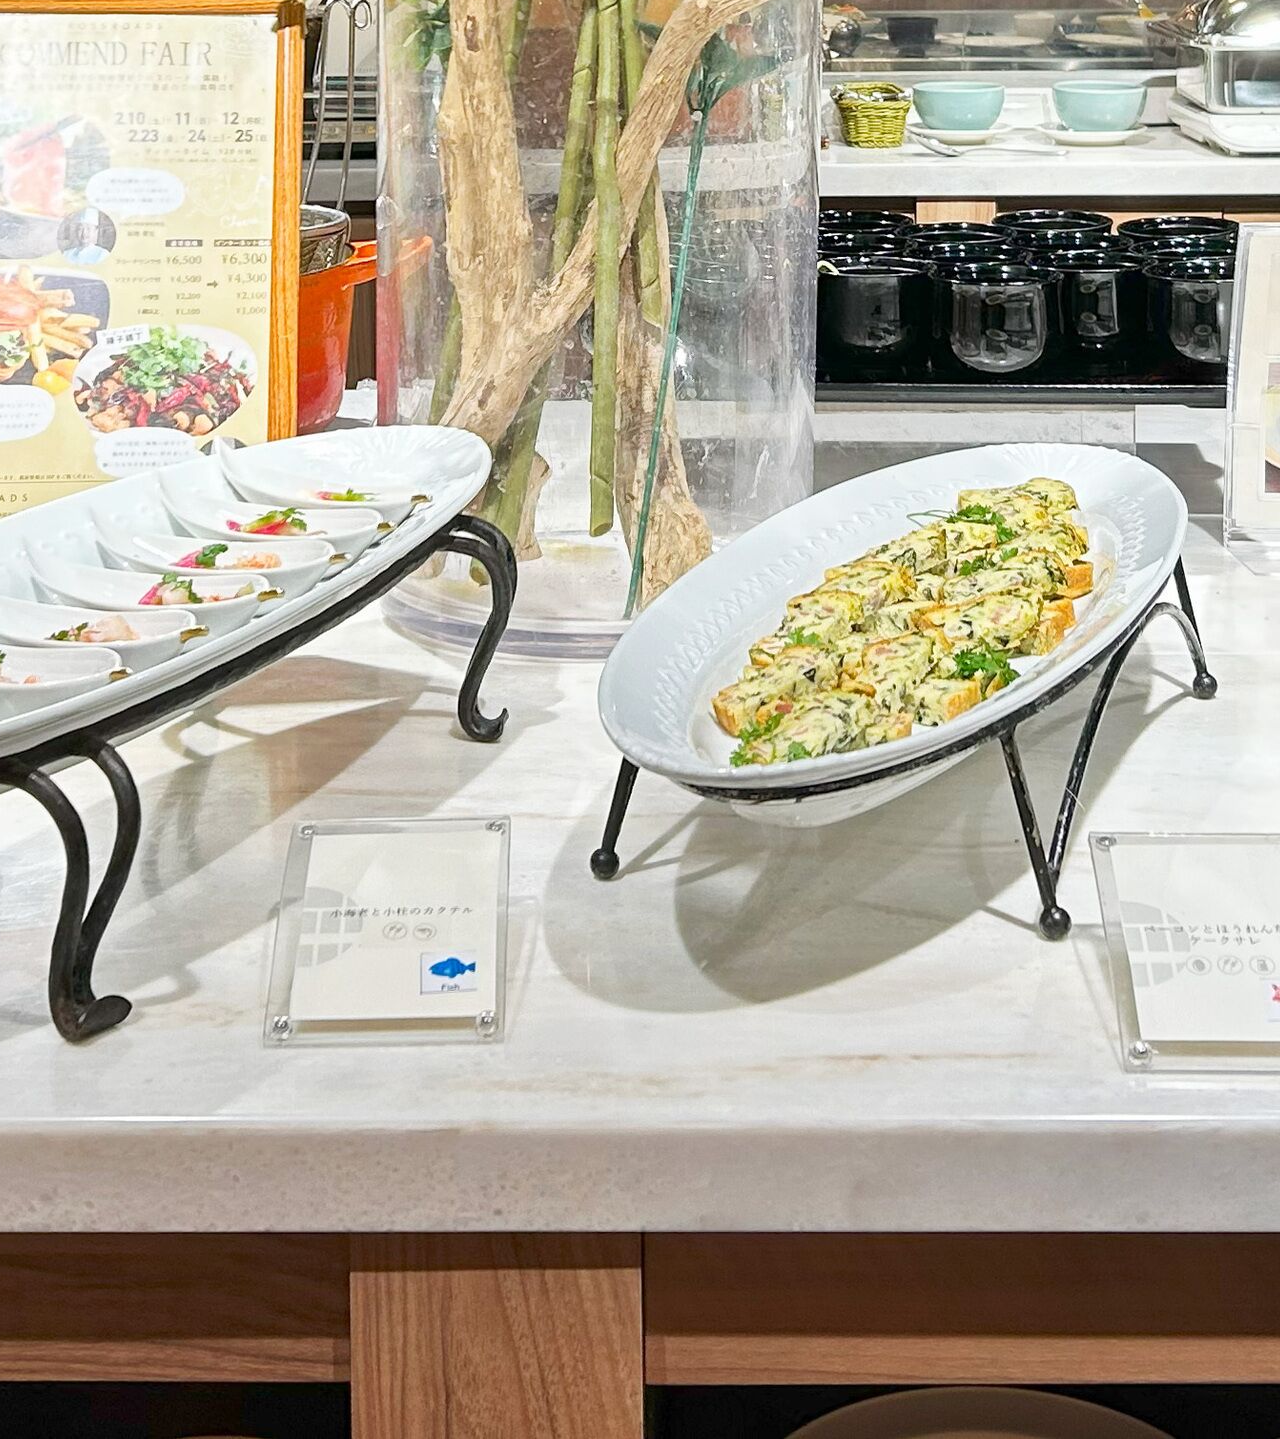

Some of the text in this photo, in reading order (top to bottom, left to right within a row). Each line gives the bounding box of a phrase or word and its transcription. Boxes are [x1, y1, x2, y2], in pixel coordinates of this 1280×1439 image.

[140, 41, 213, 67] FAIR
[175, 111, 191, 125] 11
[222, 111, 240, 125] 12
[187, 129, 207, 143] 24
[234, 129, 254, 143] 25
[221, 252, 268, 266] ¥6,300
